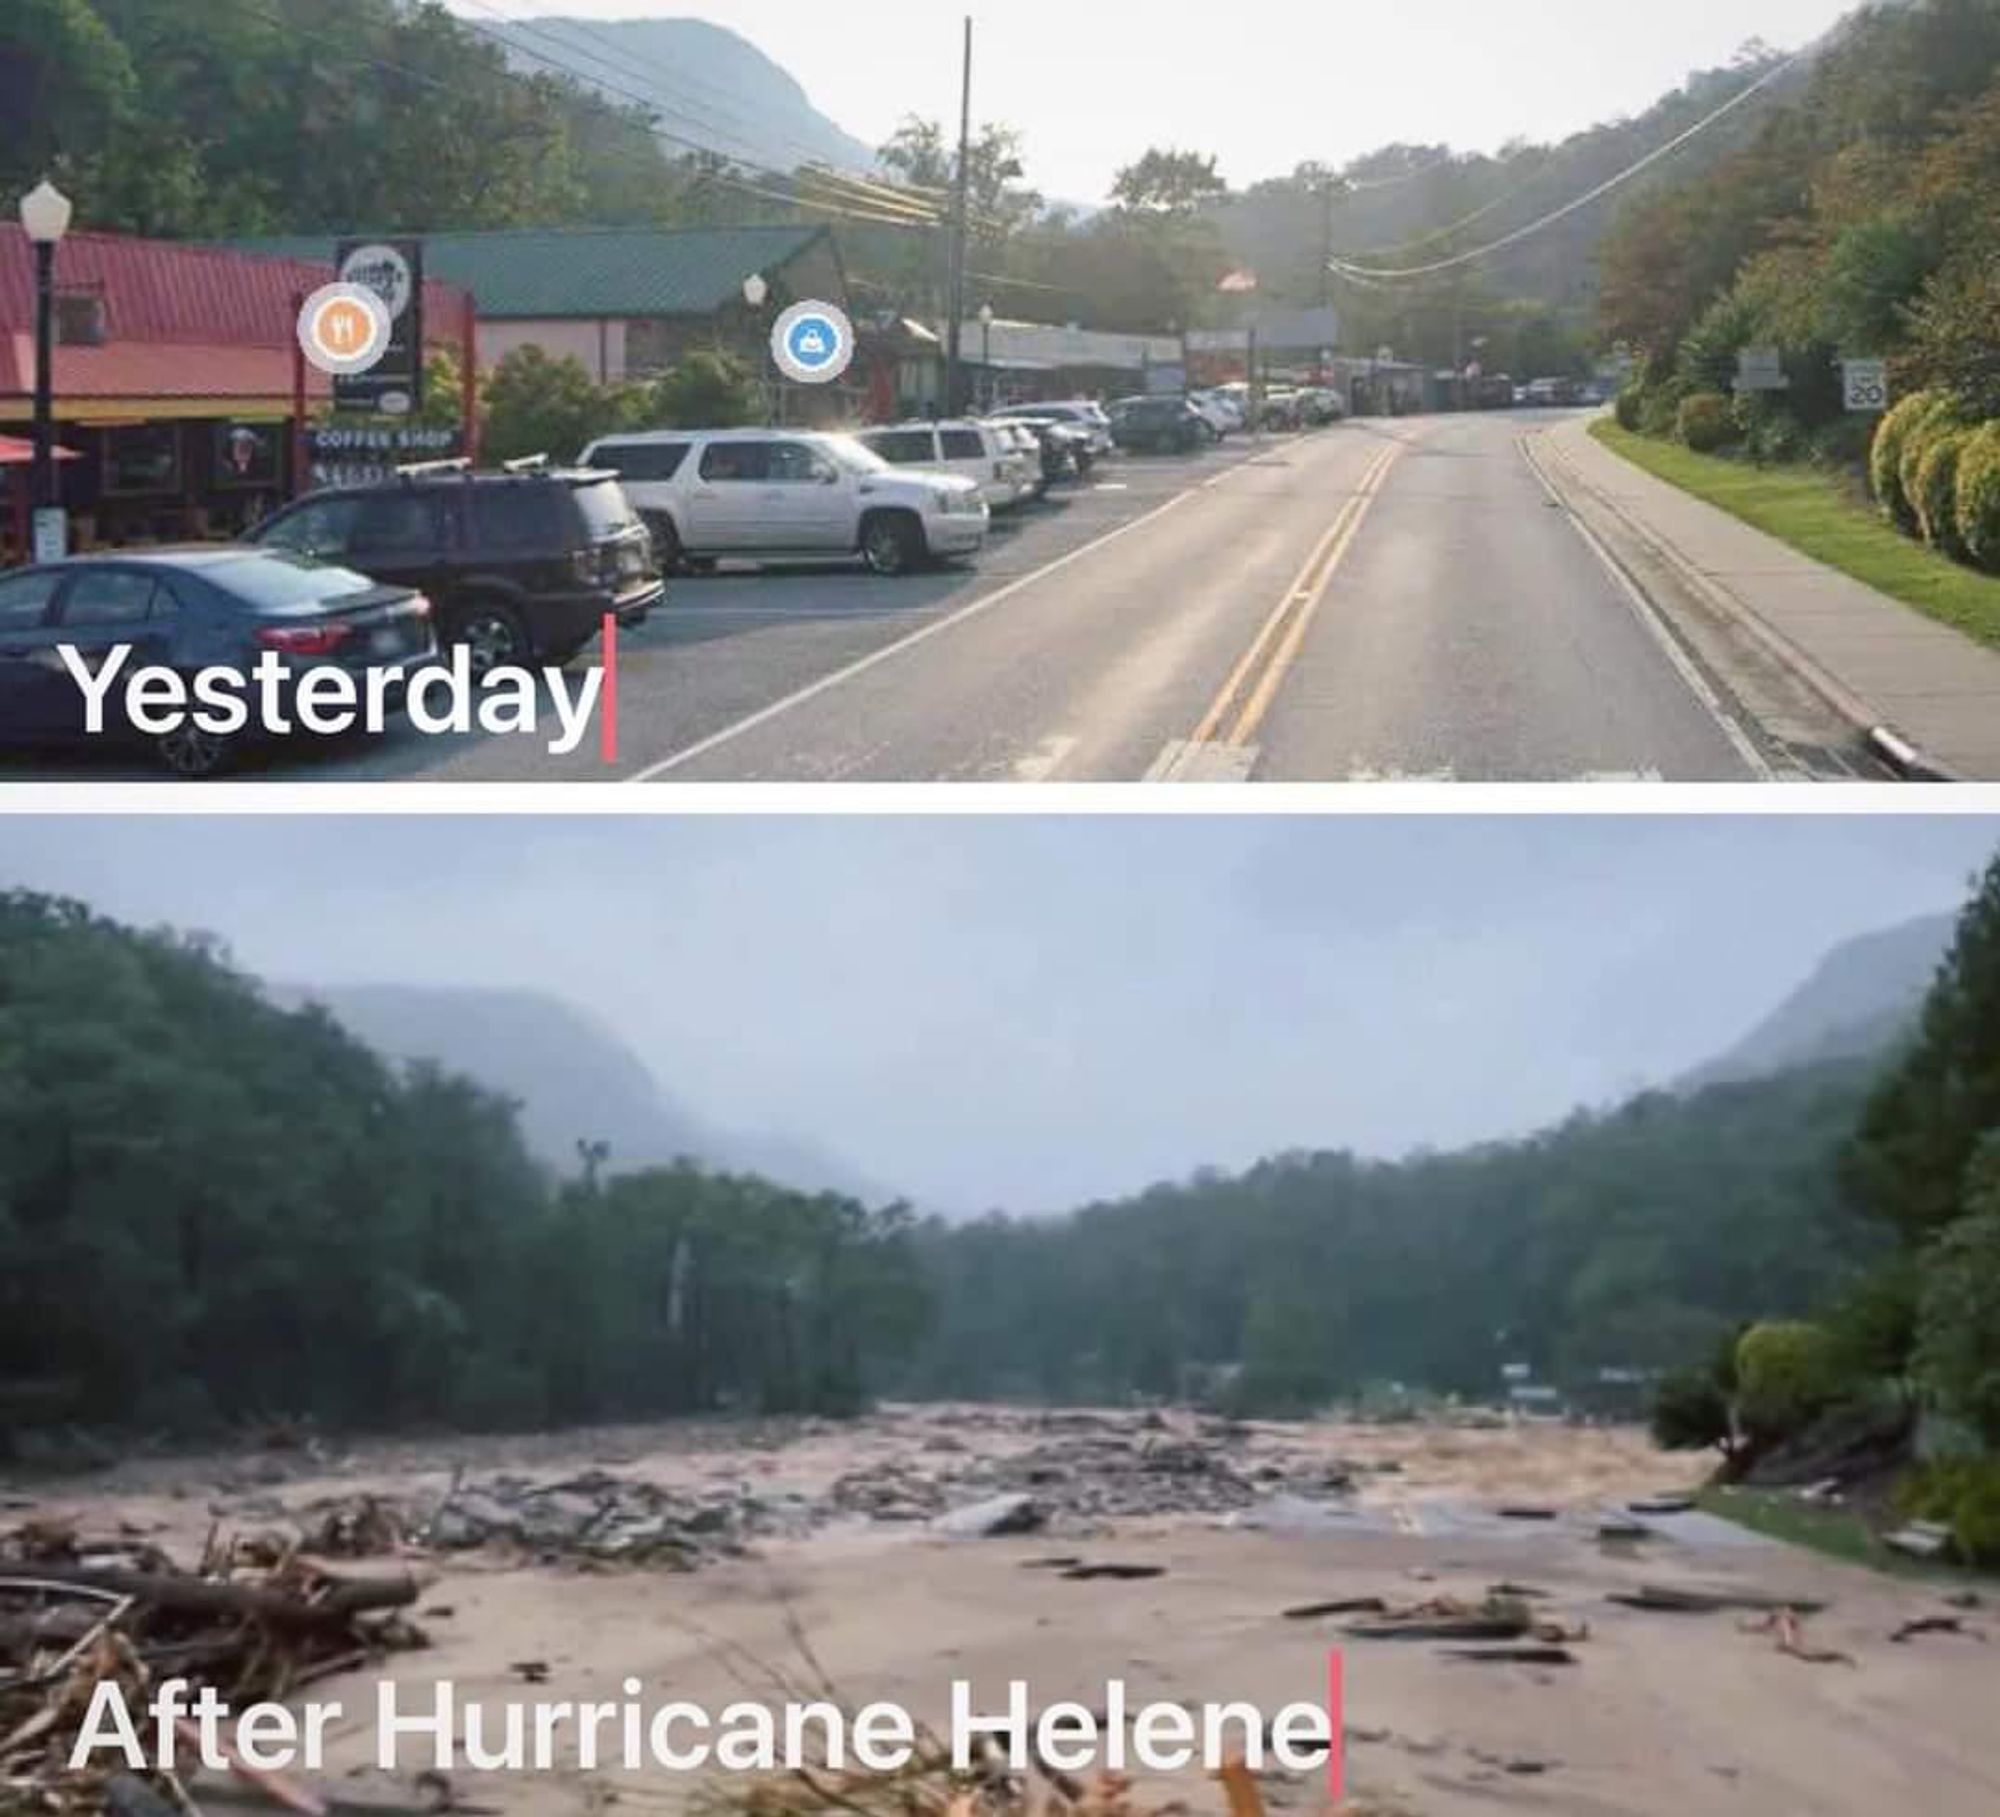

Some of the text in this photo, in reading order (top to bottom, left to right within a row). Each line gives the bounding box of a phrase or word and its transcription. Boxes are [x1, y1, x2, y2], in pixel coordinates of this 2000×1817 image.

[1850, 384, 1883, 405] 20
[314, 429, 453, 447] COFFEE SHOP
